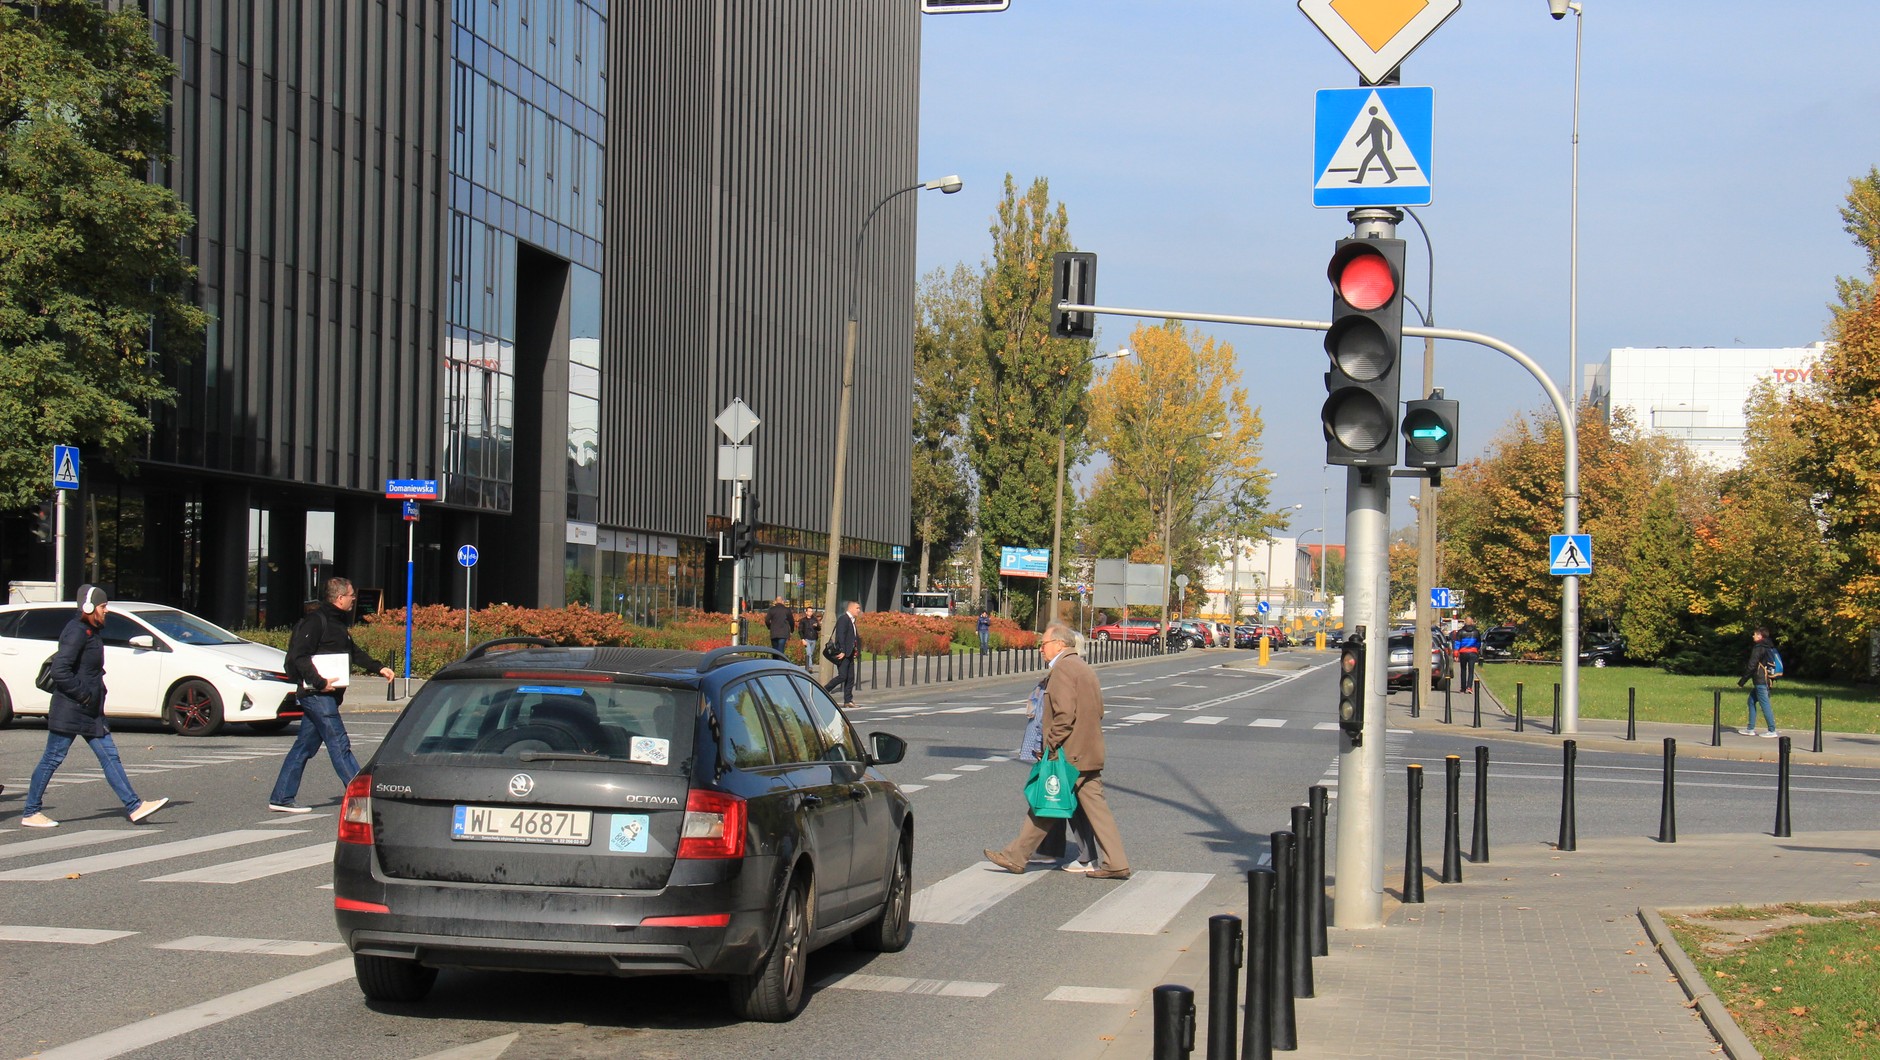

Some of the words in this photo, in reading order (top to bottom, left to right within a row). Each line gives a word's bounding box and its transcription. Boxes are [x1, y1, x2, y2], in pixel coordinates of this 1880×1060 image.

[389, 484, 434, 492] Domaniewska
[1006, 554, 1017, 567] P
[376, 783, 412, 793] ŠKODA
[626, 794, 679, 805] OCTAVIA
[471, 809, 499, 833] WL
[510, 811, 583, 837] 4687L
